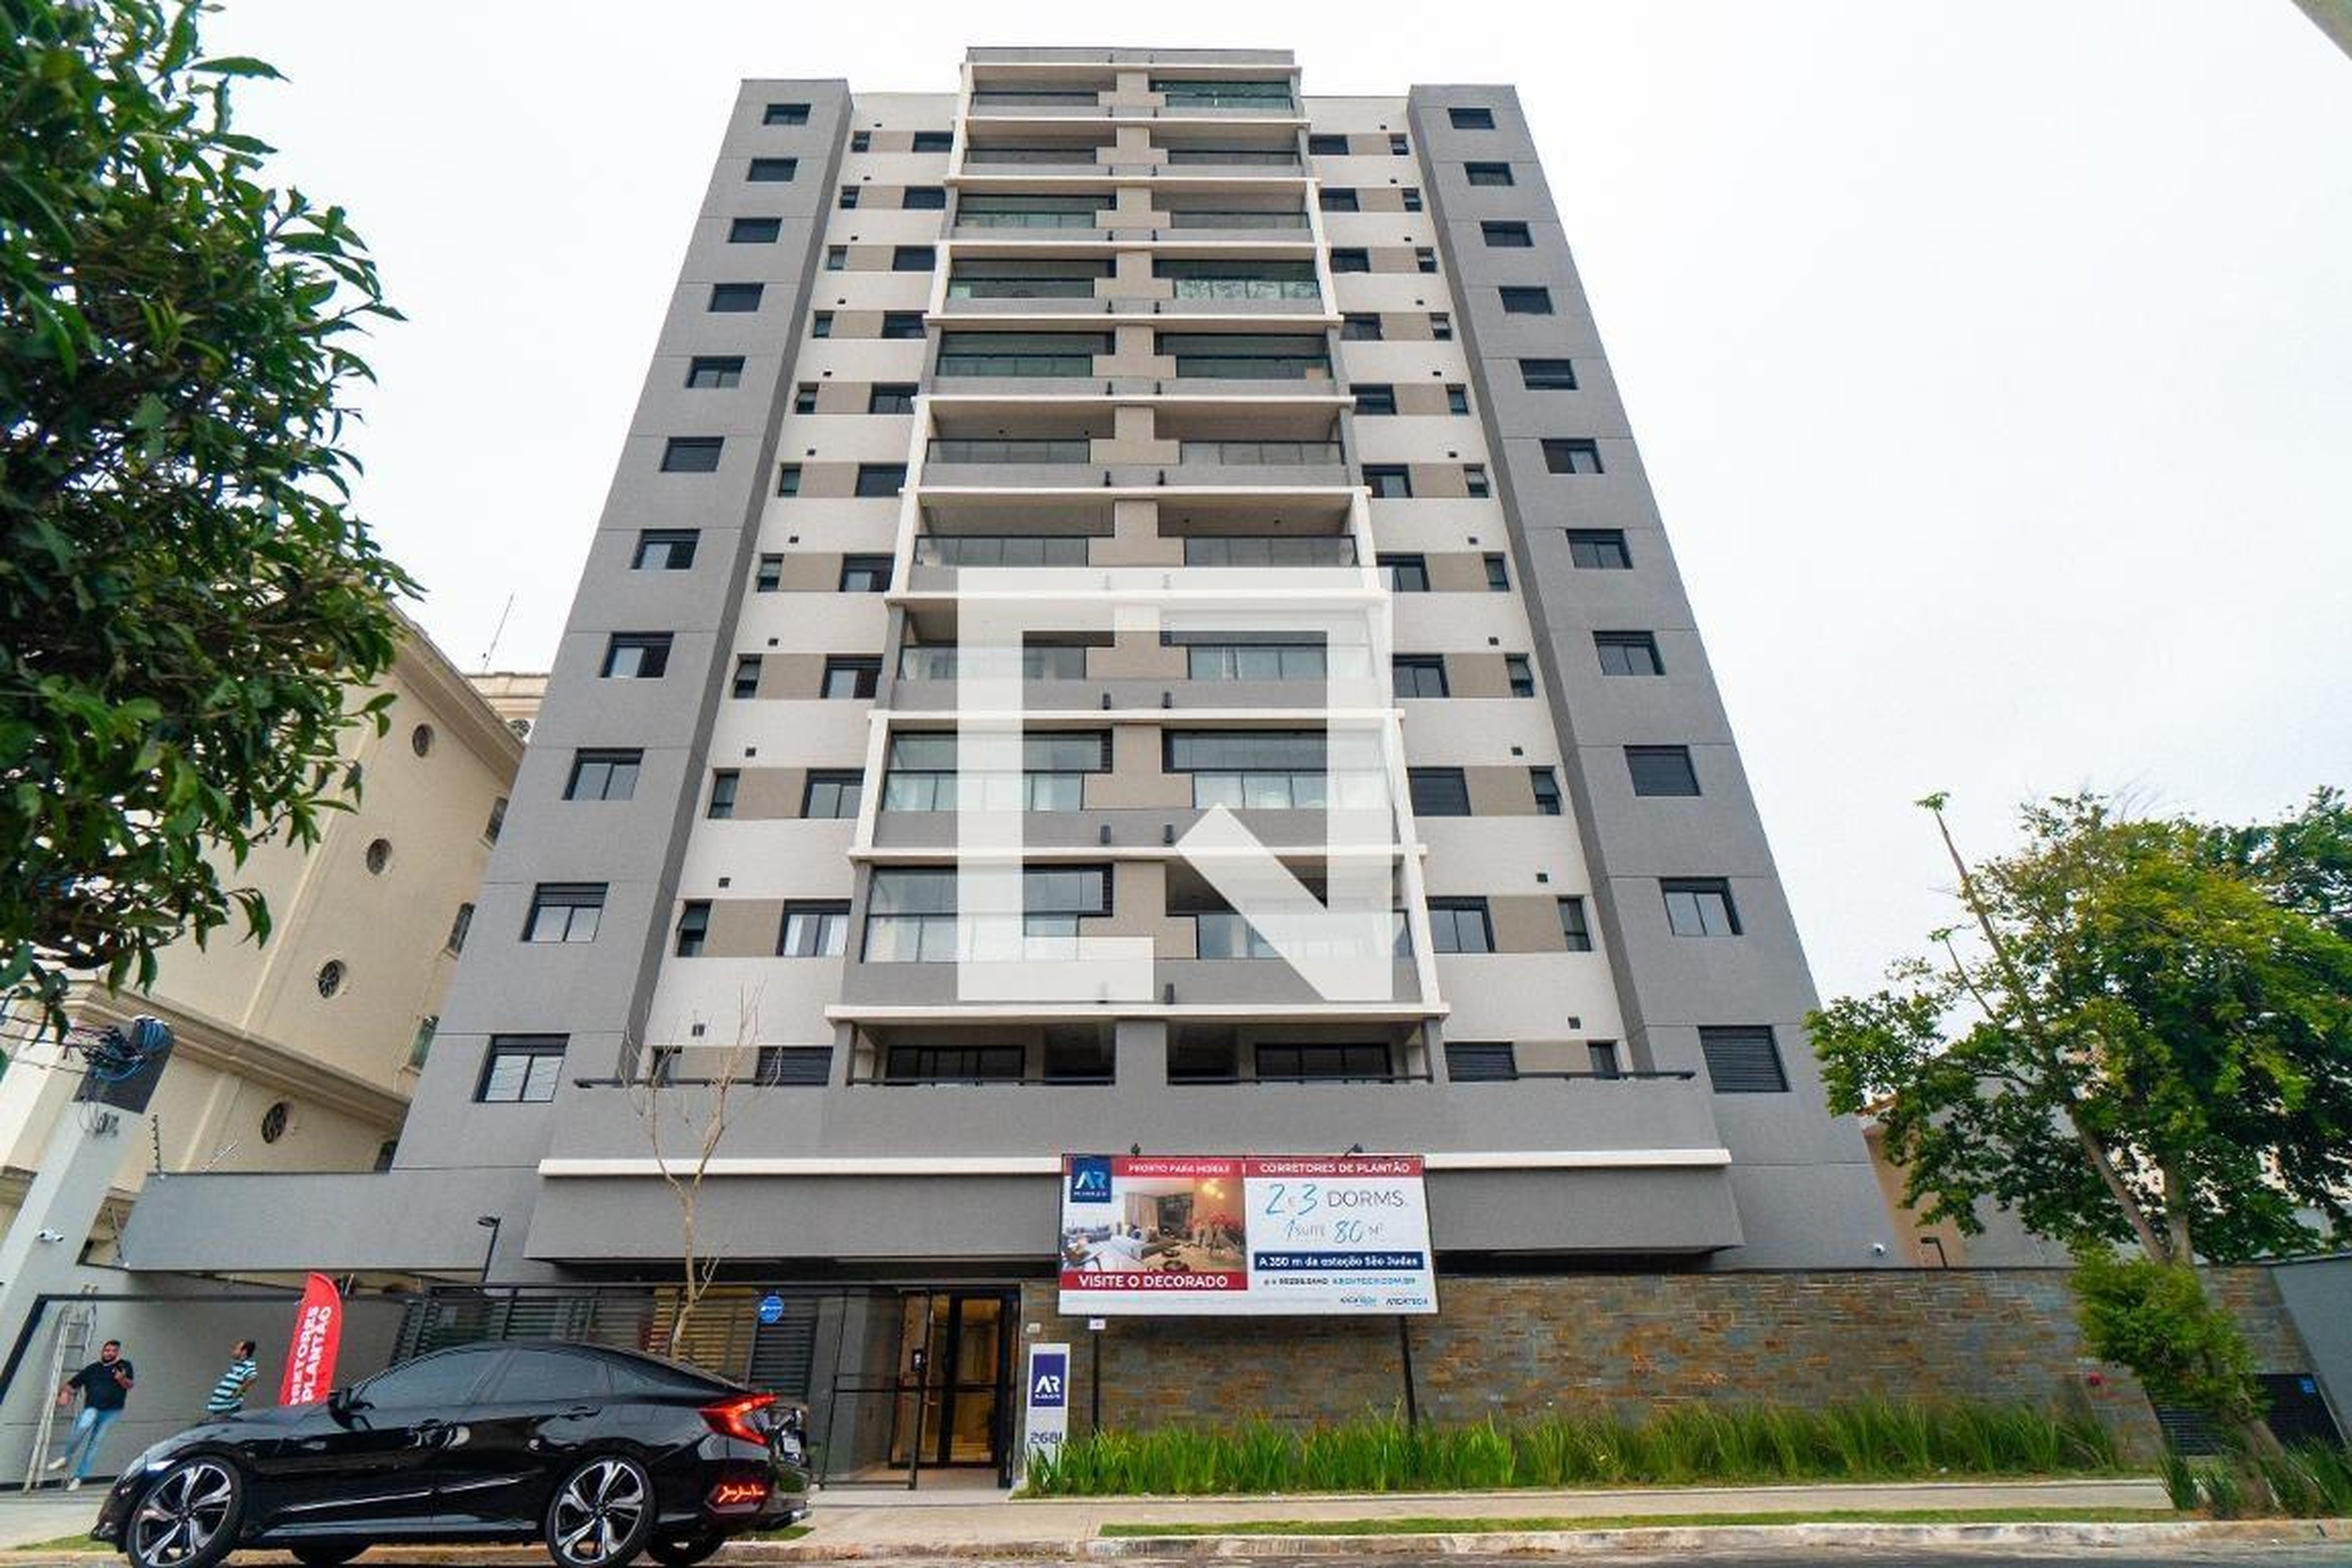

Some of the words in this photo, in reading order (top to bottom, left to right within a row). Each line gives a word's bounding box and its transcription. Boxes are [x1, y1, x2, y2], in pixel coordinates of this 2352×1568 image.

[1260, 1163, 1335, 1173] CORRETORES
[1339, 1163, 1354, 1173] DE
[1357, 1161, 1410, 1173] PLANTÃO
[1074, 1170, 1107, 1189] AR
[1266, 1183, 1284, 1215] 2
[1298, 1183, 1318, 1215] 3
[1259, 1257, 1268, 1266] A
[1305, 1257, 1317, 1266] da
[1321, 1255, 1363, 1268] estação
[1077, 1275, 1124, 1288] VISITE
[1127, 1275, 1140, 1288] O
[1143, 1275, 1228, 1288] DECORADO
[1035, 1375, 1061, 1393] AR
